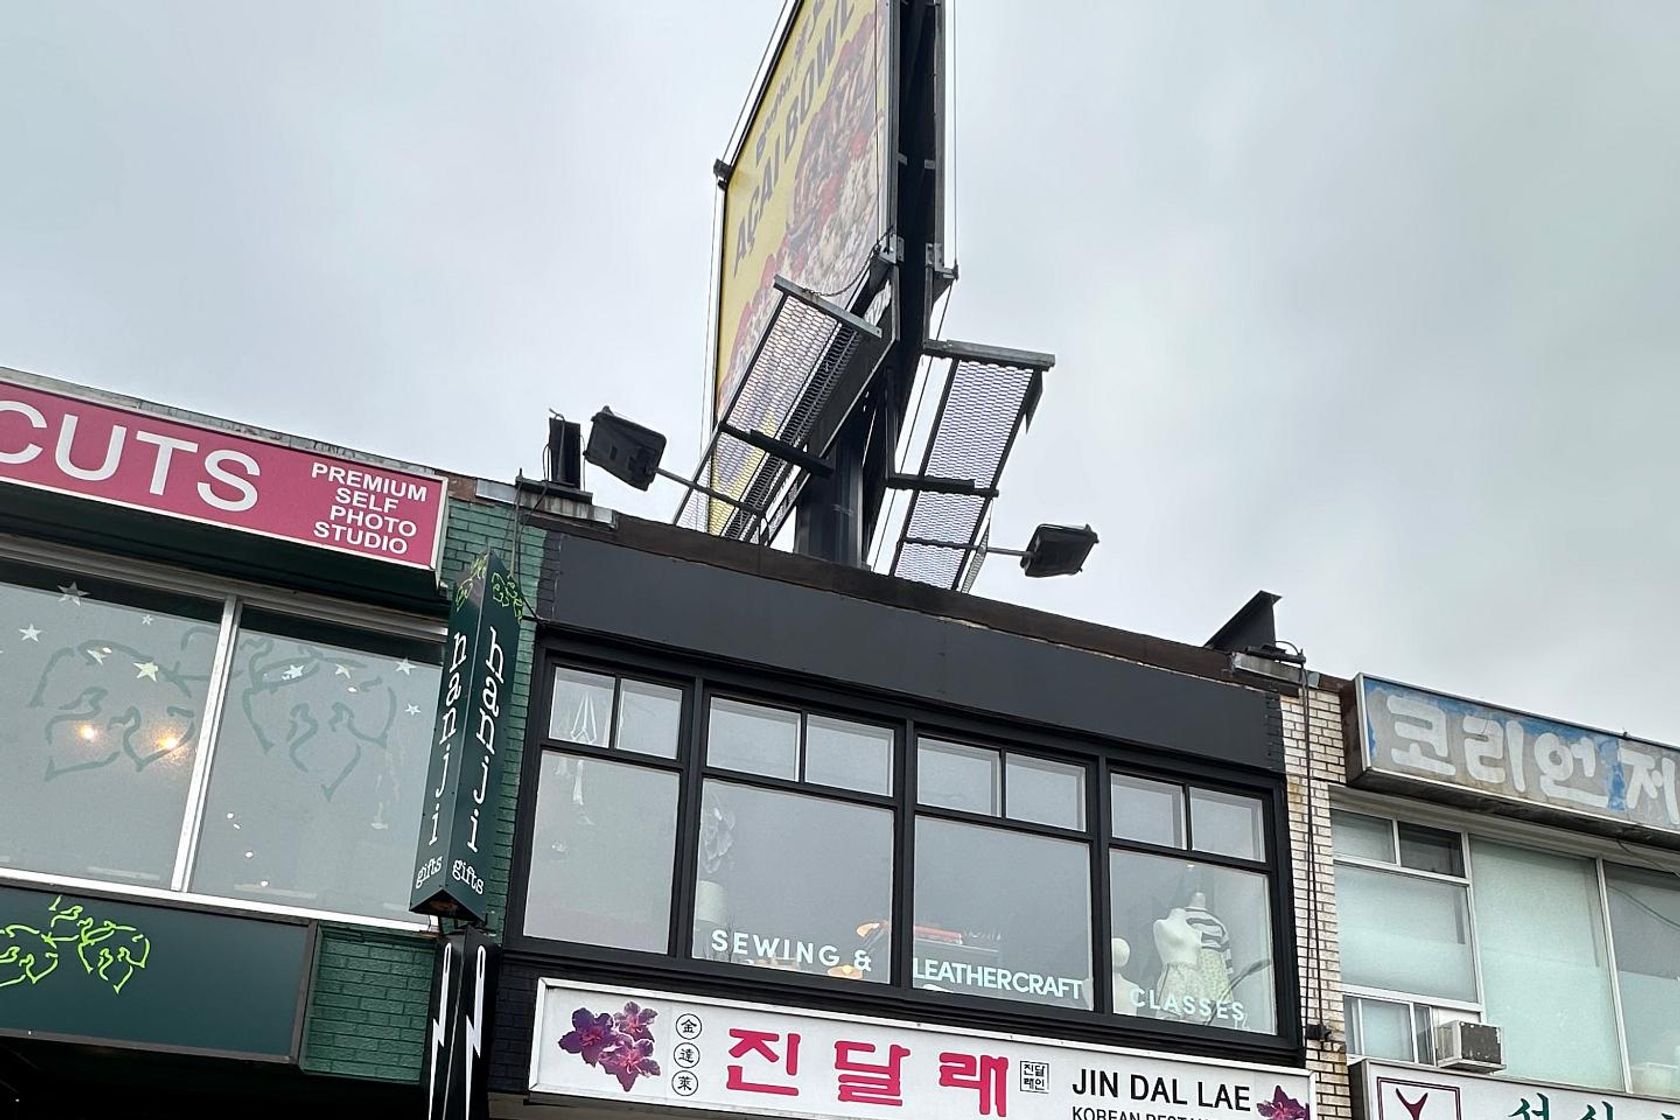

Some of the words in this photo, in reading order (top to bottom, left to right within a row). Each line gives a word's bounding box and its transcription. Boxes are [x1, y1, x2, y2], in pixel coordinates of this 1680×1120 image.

[0, 401, 260, 512] CUTS
[312, 462, 427, 502] PREMIUM
[335, 487, 398, 513] SELF
[313, 521, 408, 554] STUDIO
[330, 505, 417, 537] PHOTO
[415, 855, 443, 889] gifts
[452, 859, 484, 895] gifts
[711, 930, 841, 966] SEWING
[854, 949, 872, 972] &
[913, 958, 1084, 999] LEATHERCRAFT
[1132, 988, 1245, 1021] CLASSES
[726, 1028, 1009, 1118] 진달래
[1072, 1069, 1118, 1098] JIN
[1130, 1074, 1187, 1105] DAL
[1197, 1081, 1250, 1111] LAE
